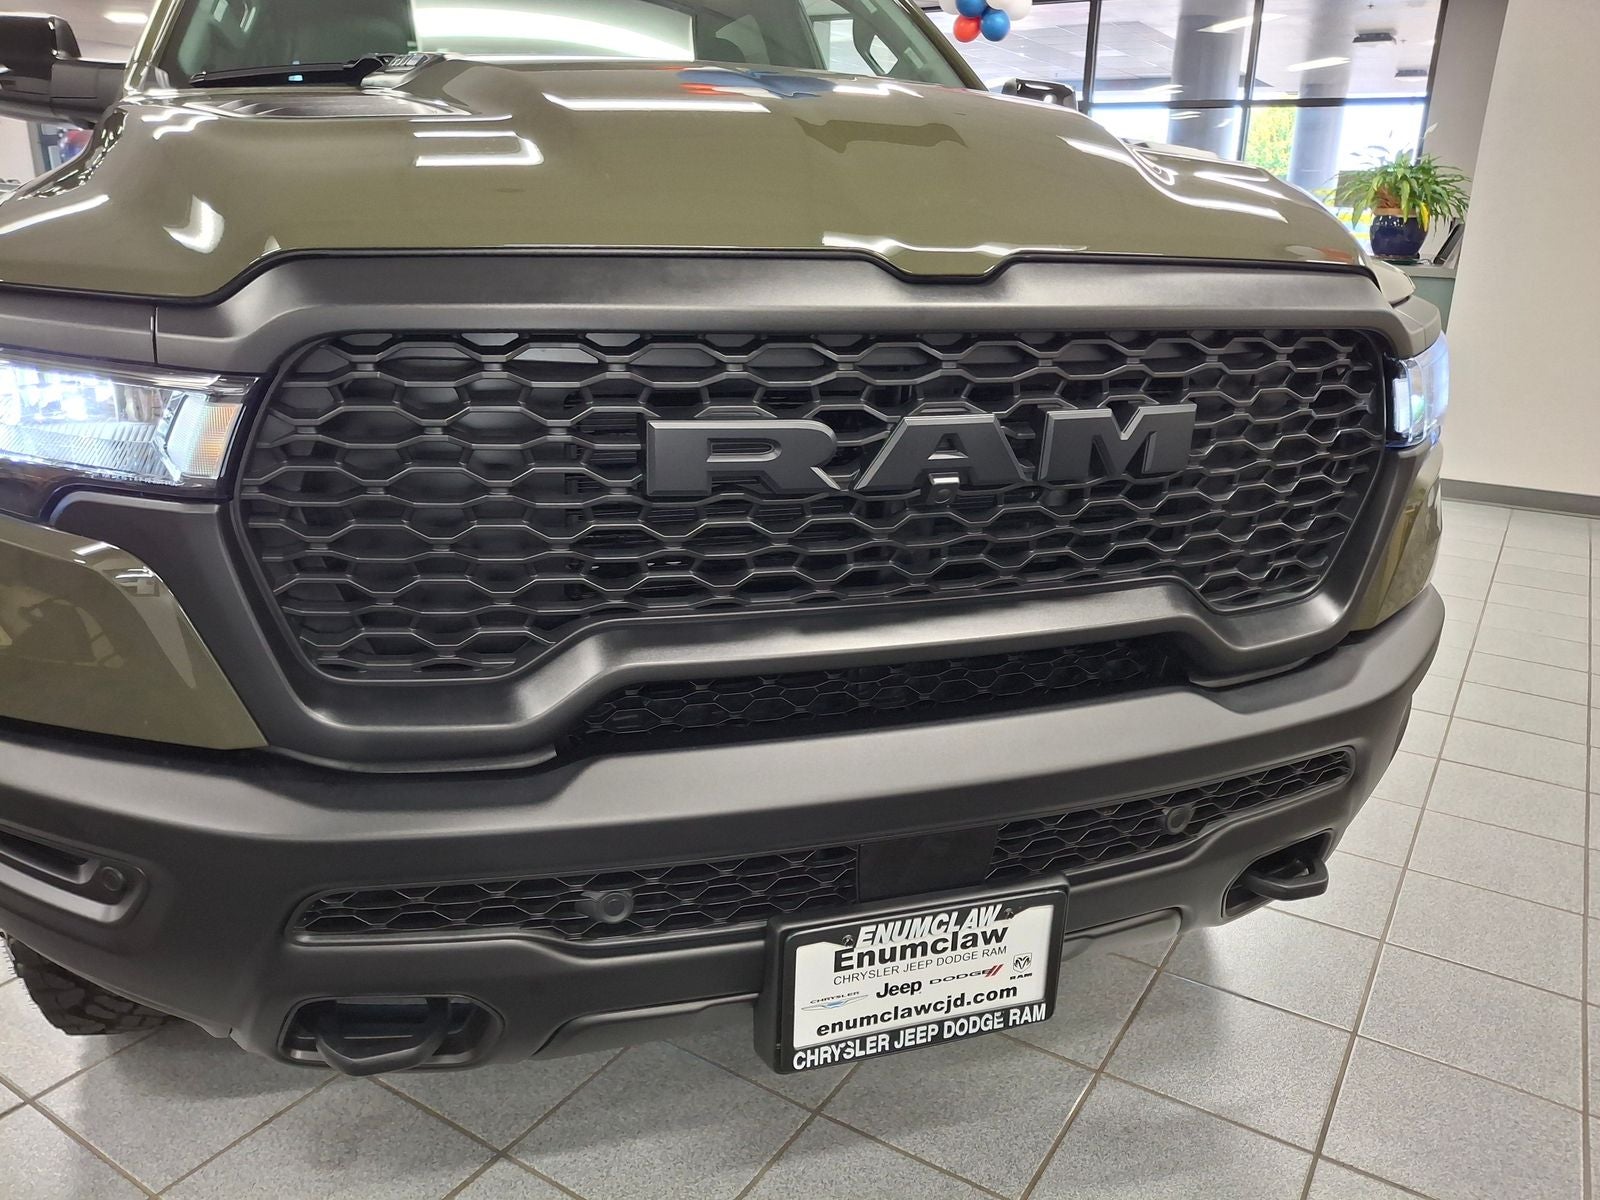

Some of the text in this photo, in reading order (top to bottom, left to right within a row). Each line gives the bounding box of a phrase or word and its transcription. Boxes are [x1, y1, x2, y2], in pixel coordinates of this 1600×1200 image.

[646, 402, 1198, 496] RAM
[856, 904, 1003, 949] ENUMCLAW
[833, 926, 1008, 973] Enumclaw
[833, 945, 1007, 986] CHRYSLER JEEP DODGE RAM
[809, 991, 860, 1004] CHRYSLER
[876, 980, 922, 999] Jeep
[929, 968, 991, 985] DODGE
[1009, 972, 1033, 981] RAM
[816, 984, 1018, 1037] enumclawcjd.com
[793, 1003, 1046, 1071] CHRYSLER JEEP DODGE RAM
